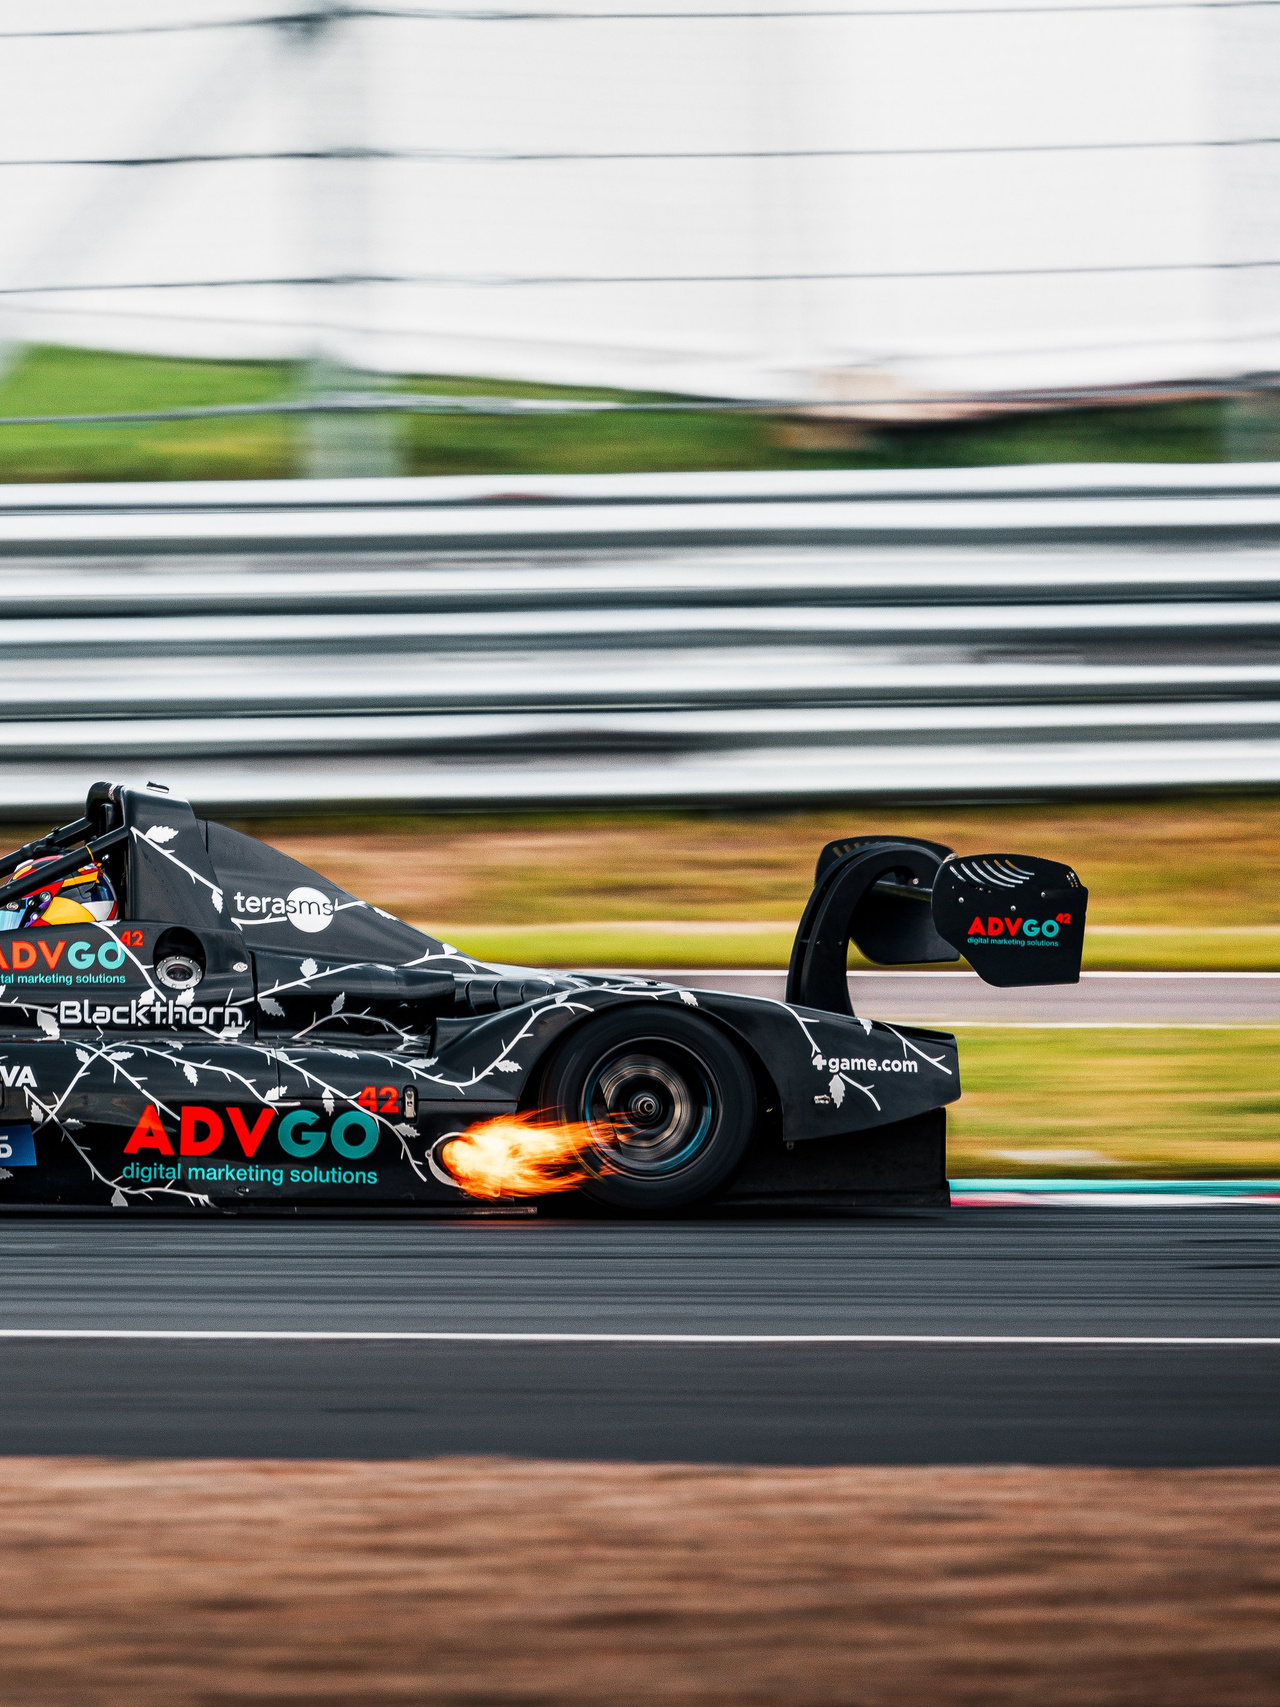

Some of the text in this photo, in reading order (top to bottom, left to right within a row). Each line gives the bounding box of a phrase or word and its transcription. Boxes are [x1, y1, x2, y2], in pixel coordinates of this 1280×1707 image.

[233, 891, 334, 916] terasms
[967, 912, 1071, 938] ADVGO 42
[120, 930, 144, 947] 42
[967, 937, 1059, 947] digital marketing solutions
[17, 973, 73, 986] marketing
[75, 973, 126, 984] solutions
[60, 999, 243, 1025] Blackthorn
[812, 1054, 918, 1073] 4game.com
[123, 1085, 400, 1160] ADVGO 42
[122, 1162, 378, 1186] digital marketing solutions
